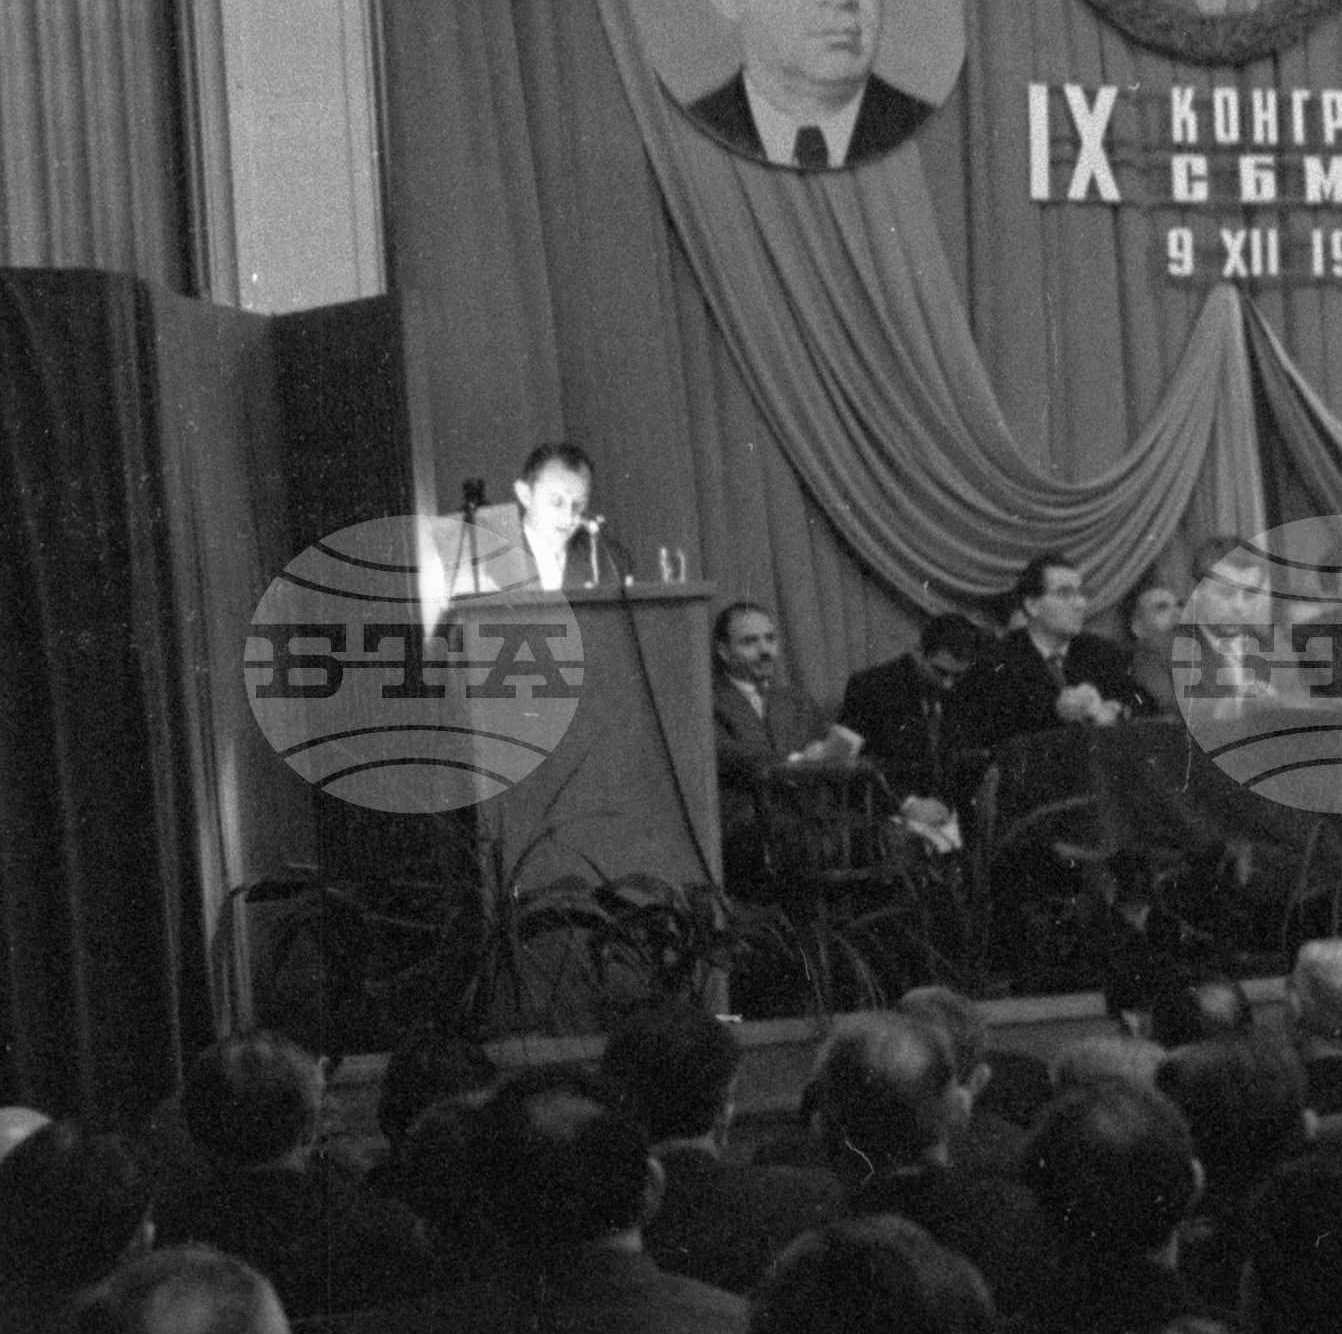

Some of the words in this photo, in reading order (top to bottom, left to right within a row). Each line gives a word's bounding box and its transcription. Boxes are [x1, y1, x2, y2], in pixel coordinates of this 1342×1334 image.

[1028, 83, 1121, 202] IX
[1167, 227, 1195, 278] 9
[1219, 228, 1280, 279] XII
